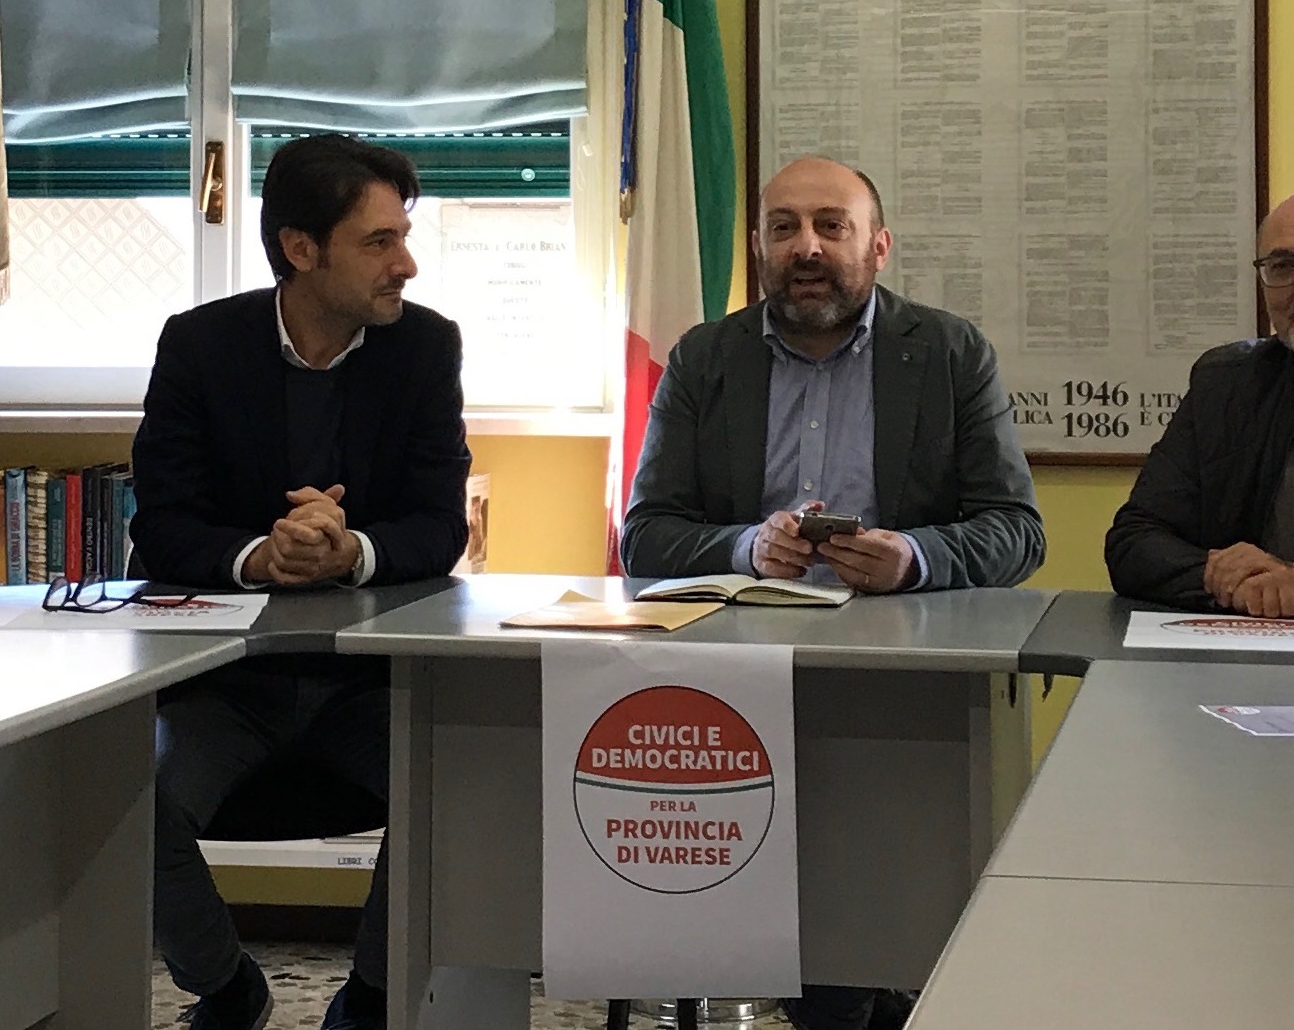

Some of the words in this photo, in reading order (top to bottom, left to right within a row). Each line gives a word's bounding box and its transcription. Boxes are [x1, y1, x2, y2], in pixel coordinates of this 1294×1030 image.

[1061, 380, 1129, 407] 1946
[1061, 412, 1129, 438] 1986
[628, 724, 700, 747] CIVICI
[707, 726, 721, 747] E
[591, 747, 759, 771] DEMOCRATICI
[650, 800, 678, 812] PER
[680, 801, 697, 812] LA
[606, 818, 743, 841] PROVINCIA
[337, 857, 362, 865] LIBRI
[617, 845, 639, 864] DI
[645, 846, 731, 866] VARESE
